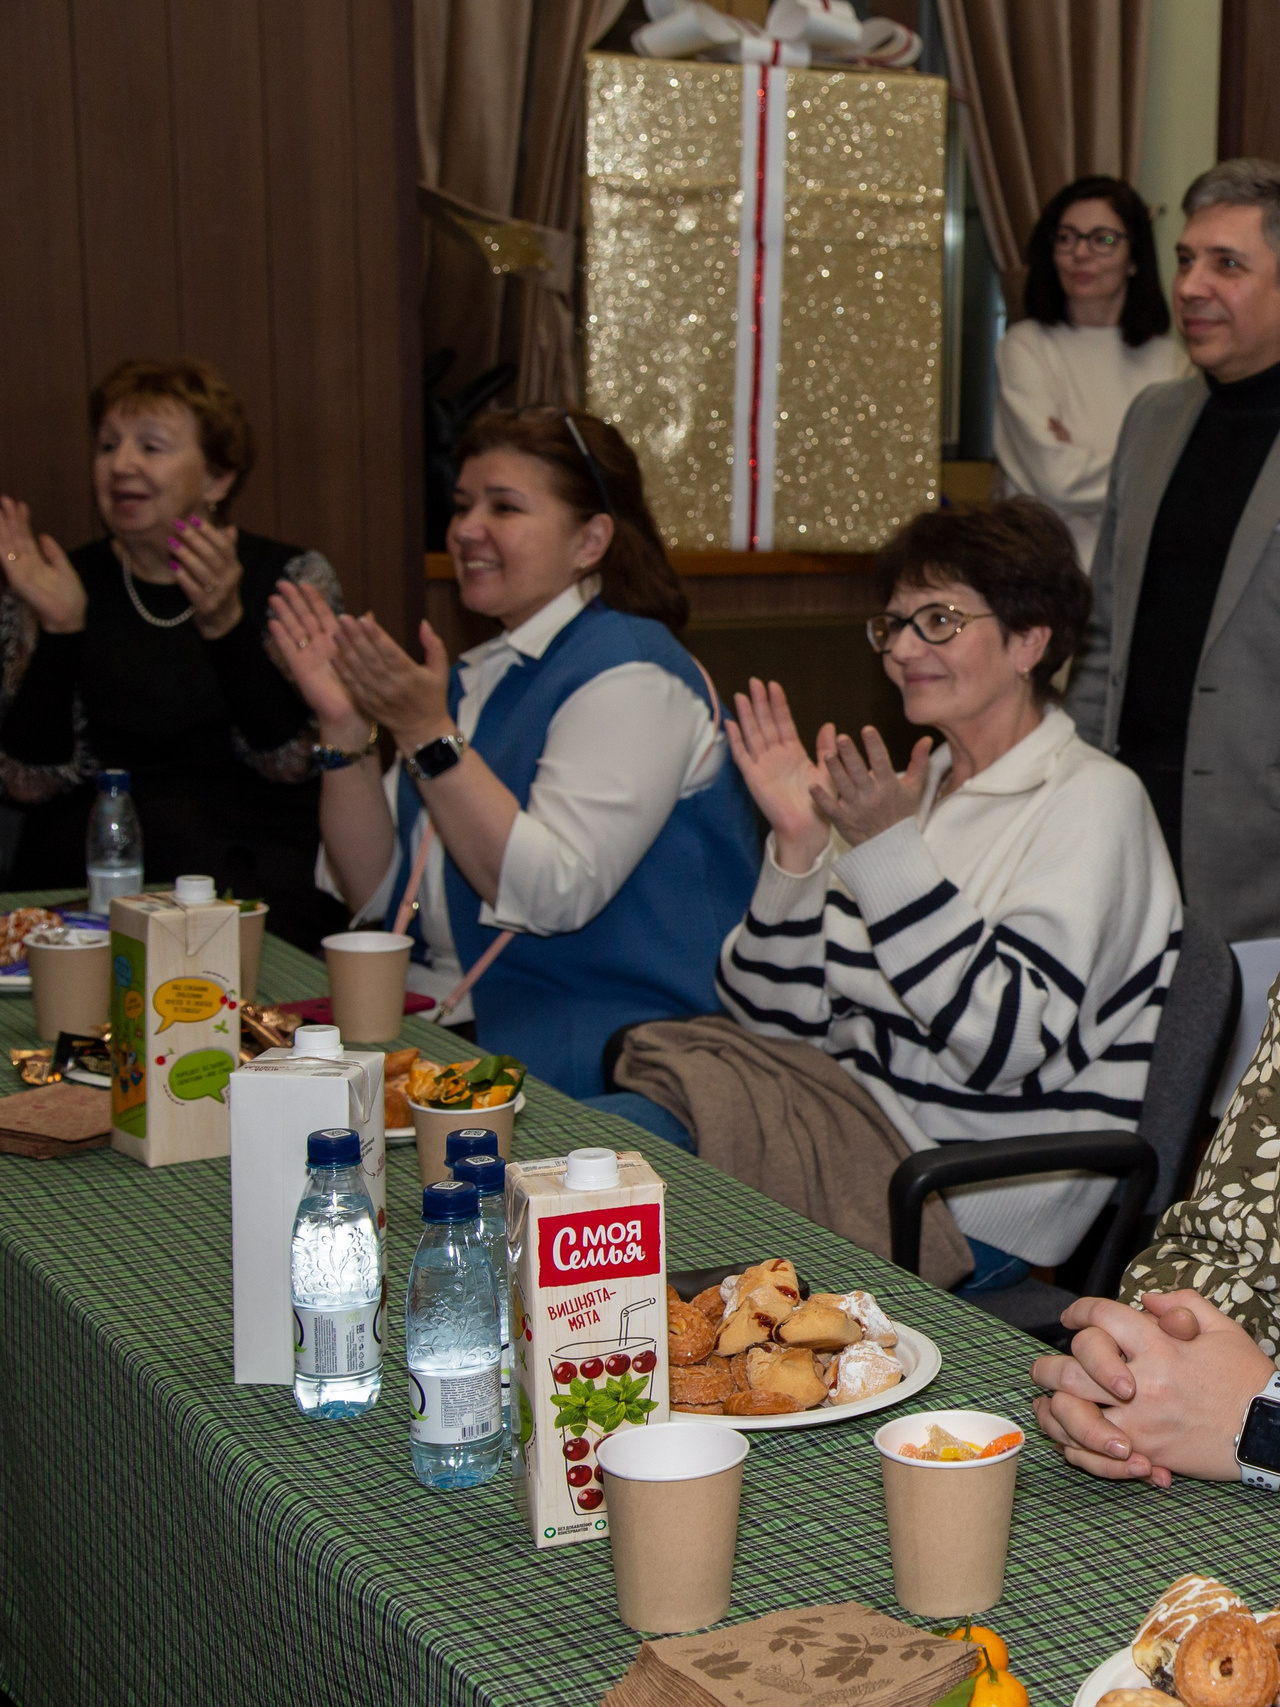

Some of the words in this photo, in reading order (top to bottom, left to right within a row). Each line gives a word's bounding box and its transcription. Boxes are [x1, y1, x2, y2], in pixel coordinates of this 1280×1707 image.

[552, 1226, 646, 1271] Семья
[583, 1219, 642, 1247] МОЯ
[547, 1287, 617, 1321] ВИШНЯТА-
[568, 1309, 601, 1332] МЯТА
